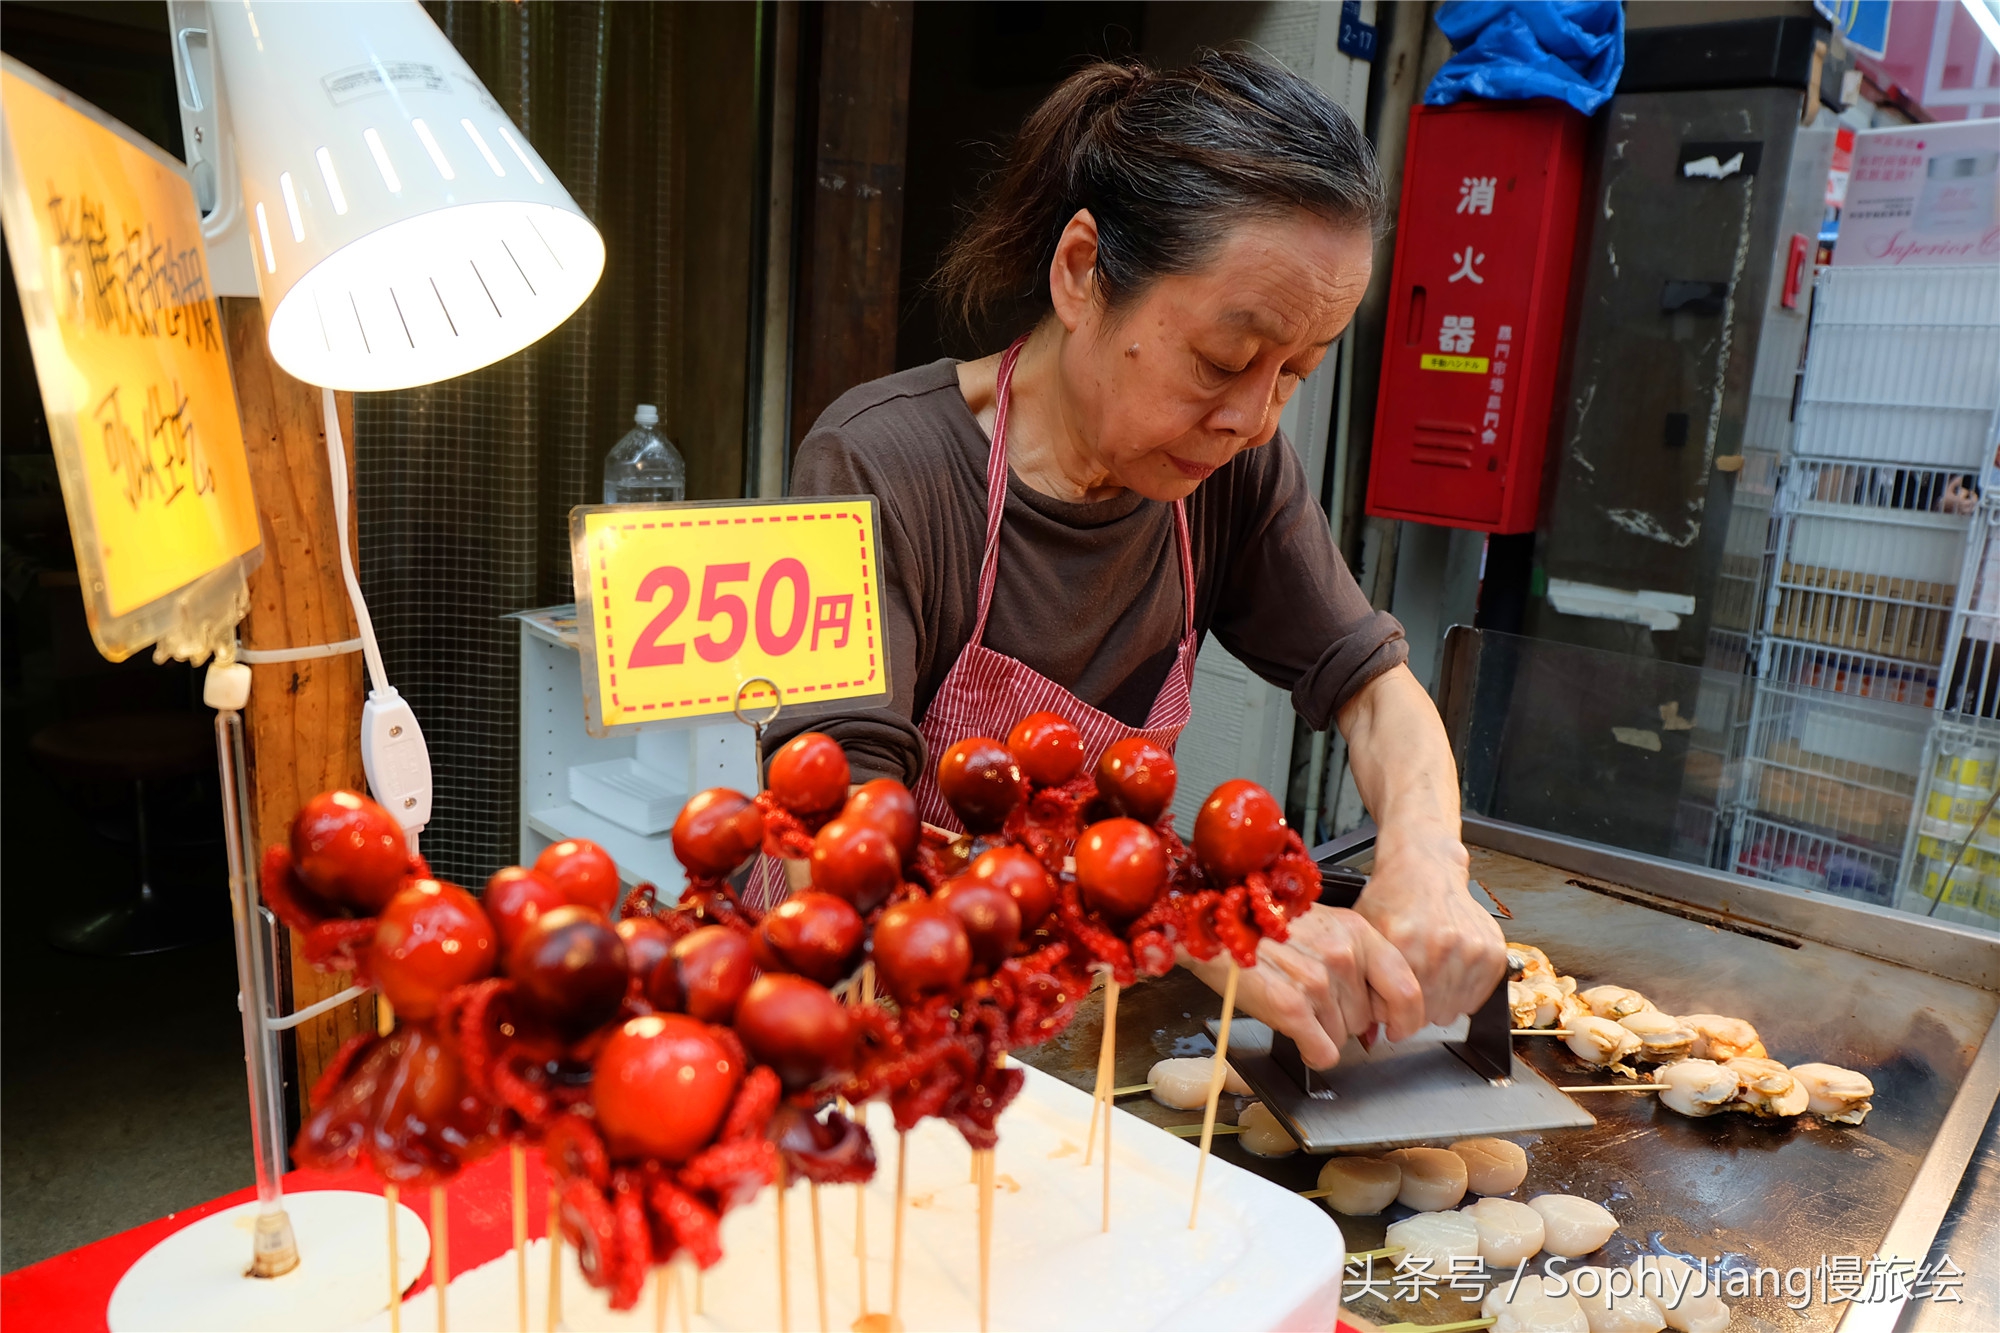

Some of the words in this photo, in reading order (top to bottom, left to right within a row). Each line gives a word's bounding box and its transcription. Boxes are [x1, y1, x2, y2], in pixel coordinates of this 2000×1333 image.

[1343, 24, 1373, 49] 2-17
[1438, 176, 1498, 354] 消火器
[1865, 230, 1975, 266] Superior
[627, 557, 854, 670] 250円
